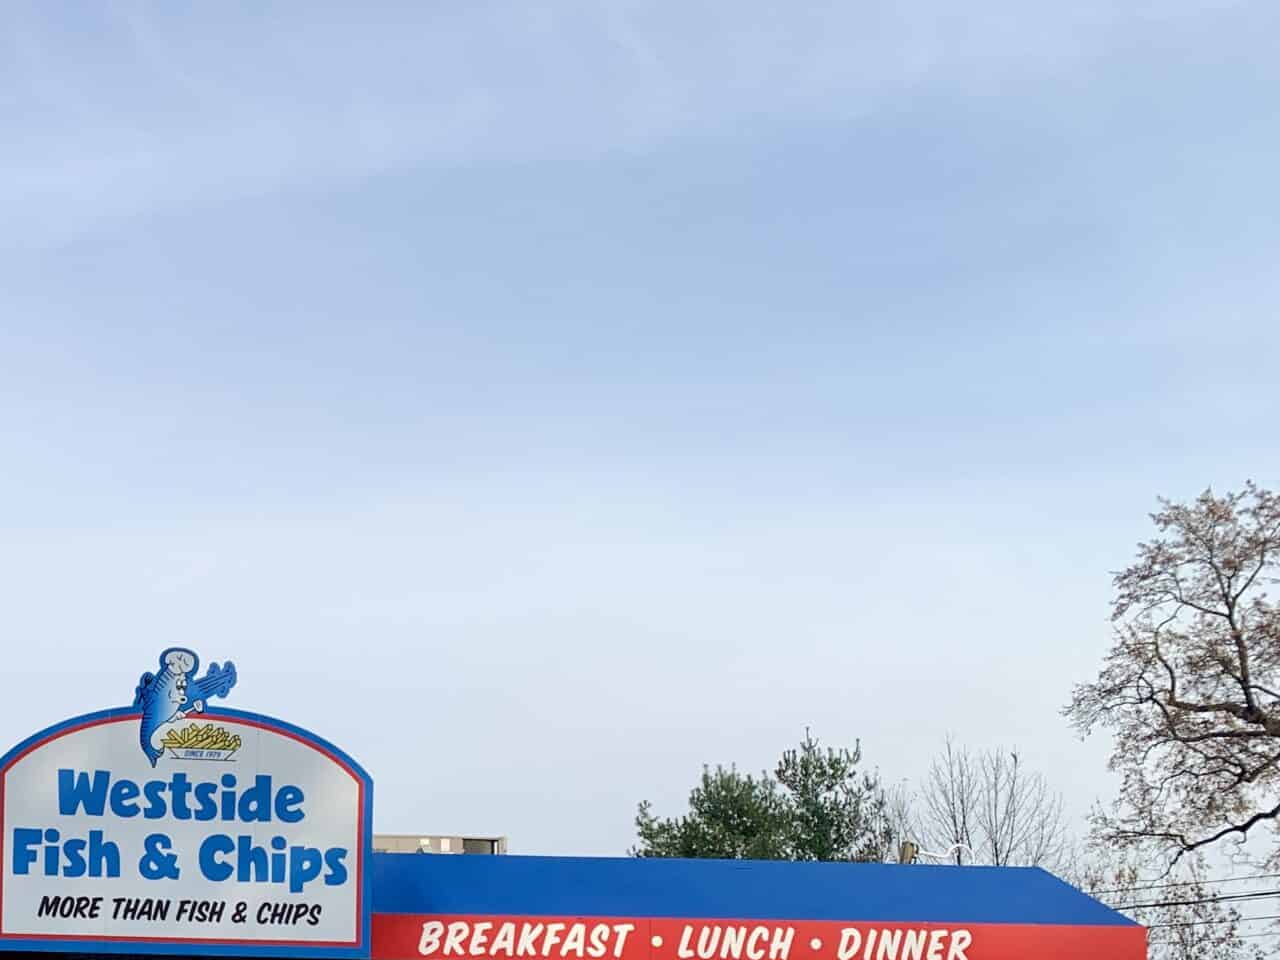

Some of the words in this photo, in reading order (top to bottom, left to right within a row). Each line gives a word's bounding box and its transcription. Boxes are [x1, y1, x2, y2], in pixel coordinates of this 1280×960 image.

[57, 768, 305, 823] Westside
[12, 827, 121, 878] Fish
[138, 833, 180, 881] &
[198, 833, 349, 894] Chips
[37, 895, 104, 919] MORE
[112, 897, 171, 922] THAN
[175, 899, 225, 924] FISH
[230, 902, 248, 924] &
[255, 902, 323, 927] CHIPS
[417, 920, 636, 958] BREAKFAST
[676, 924, 796, 960] LUNCH
